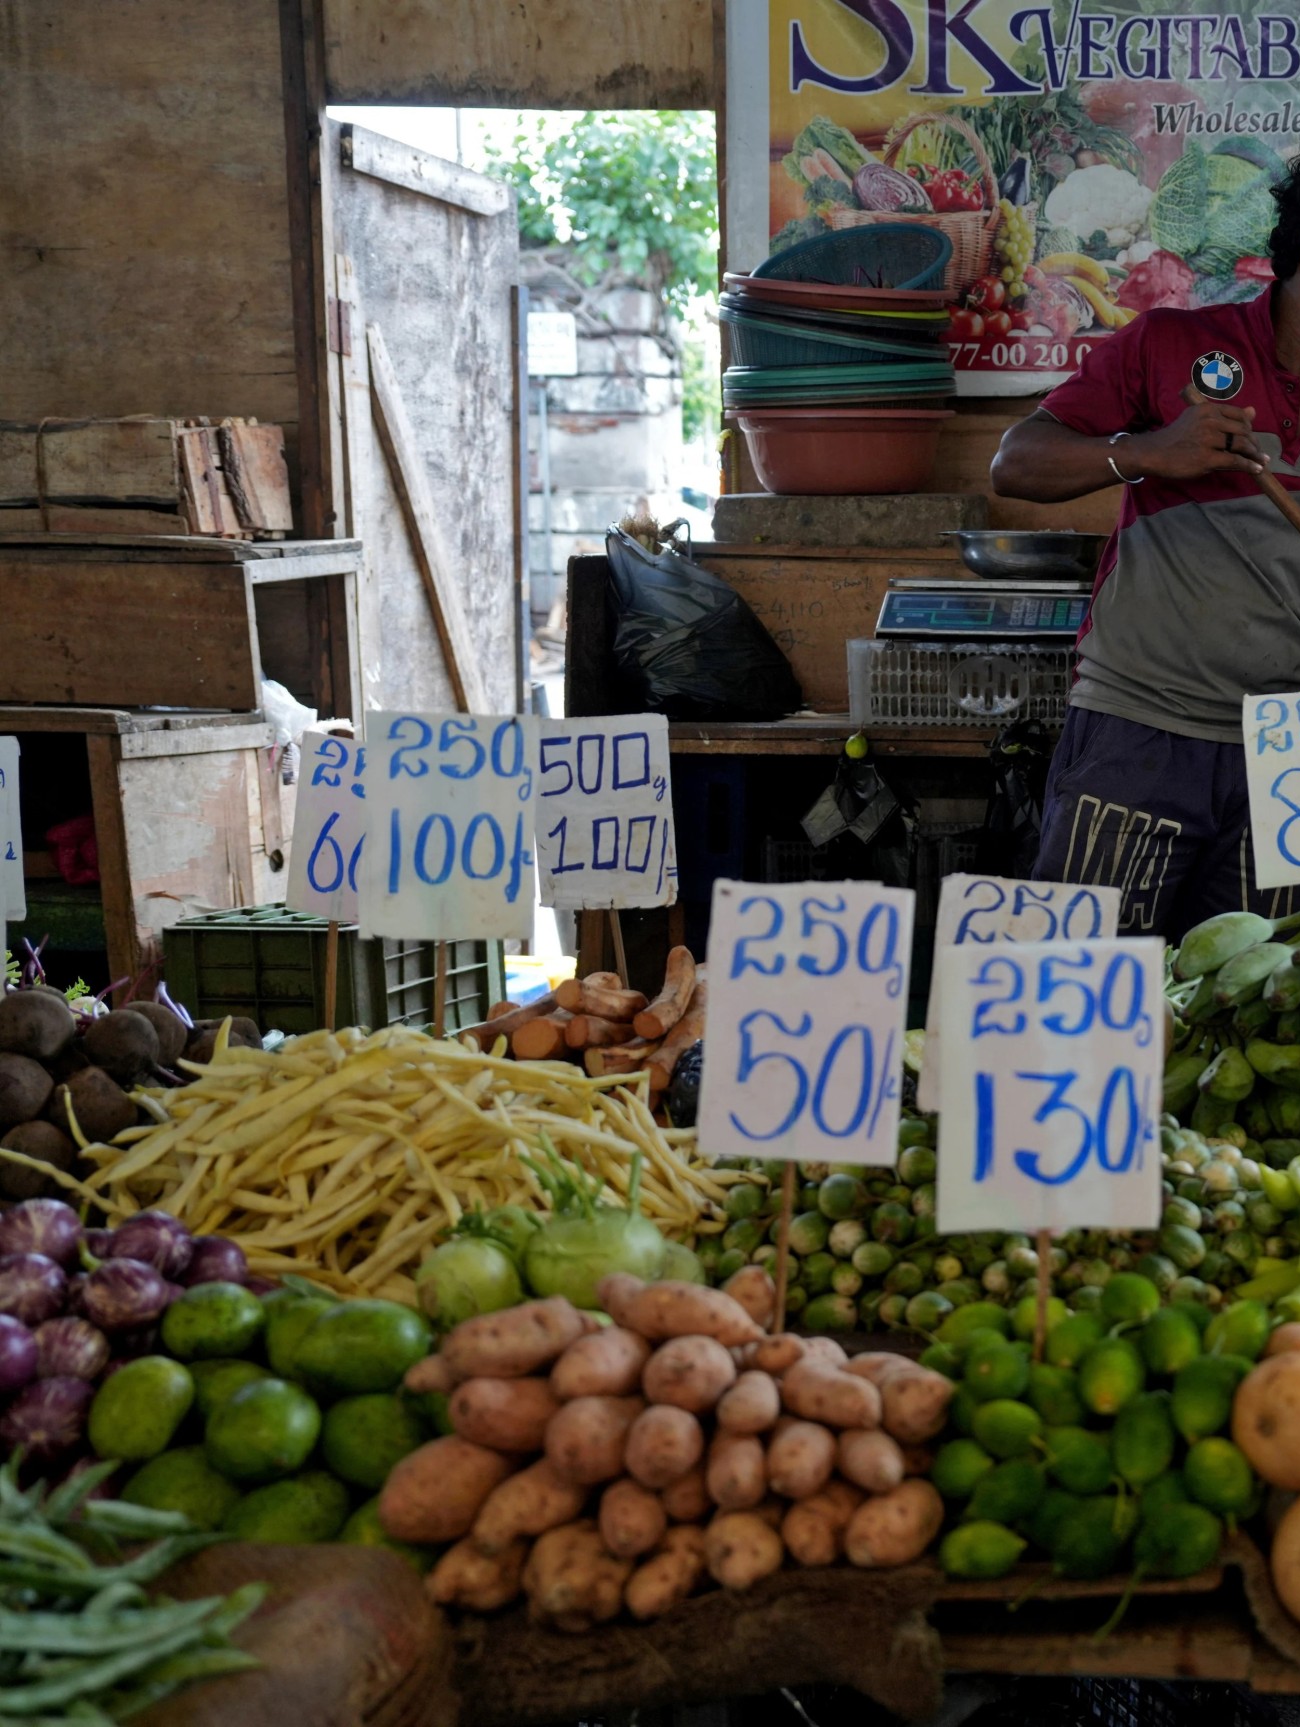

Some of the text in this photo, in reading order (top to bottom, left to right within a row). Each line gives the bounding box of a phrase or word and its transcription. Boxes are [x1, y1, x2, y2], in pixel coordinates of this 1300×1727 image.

[789, 0, 1045, 95] SK
[1034, 343, 1068, 367] 20
[1199, 352, 1240, 372] BMW
[388, 716, 533, 800] 250g
[540, 732, 668, 800] 500g
